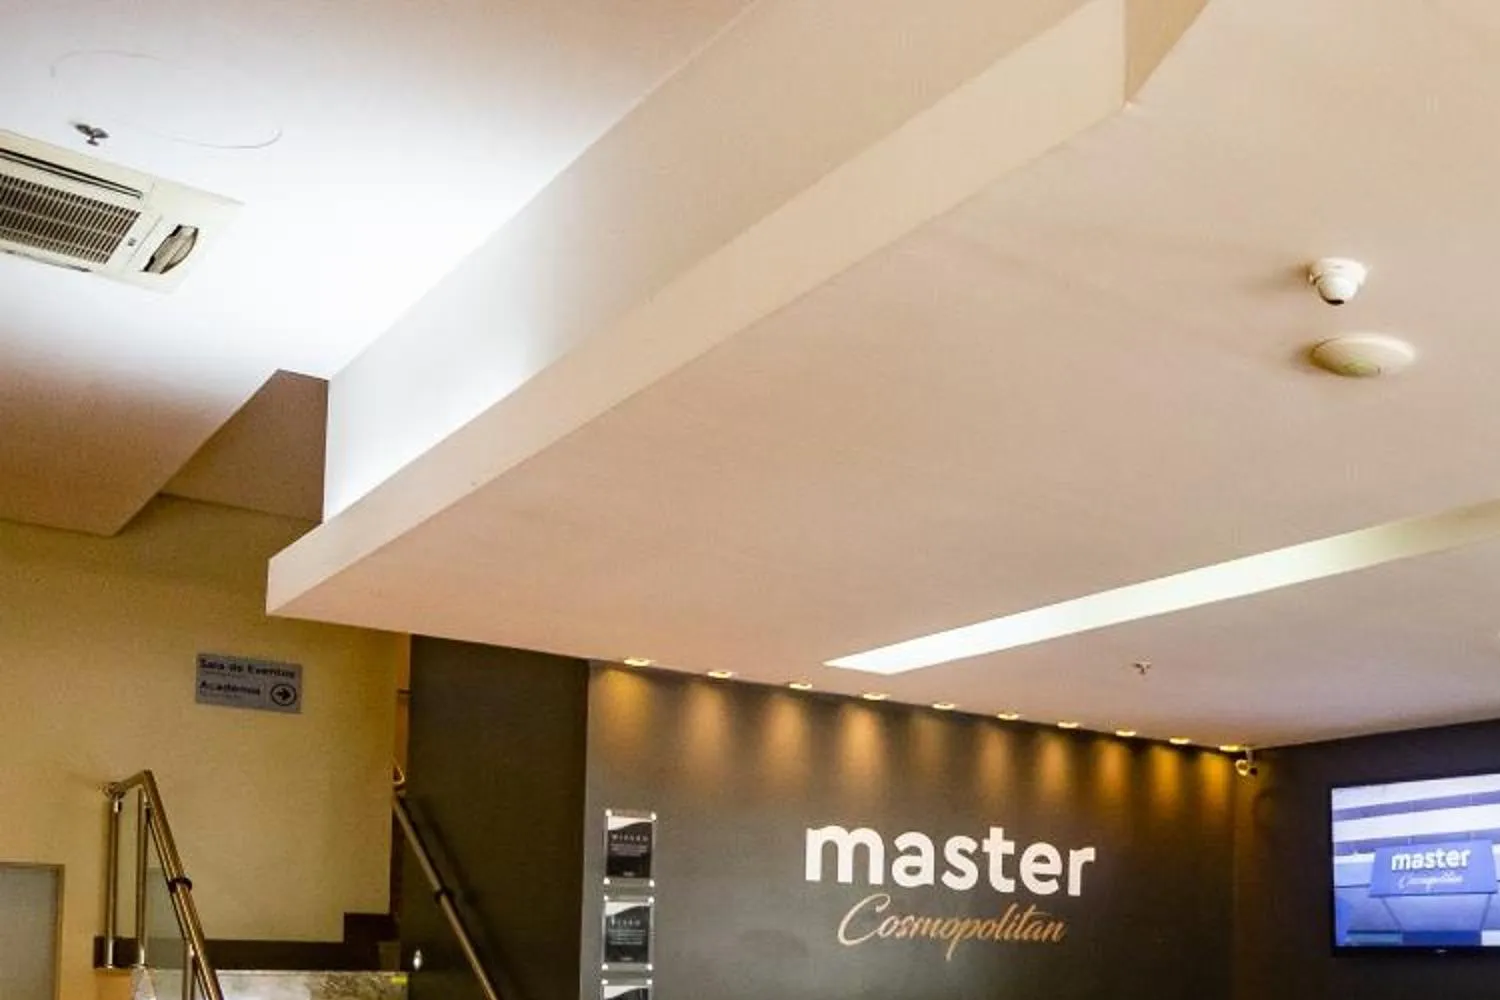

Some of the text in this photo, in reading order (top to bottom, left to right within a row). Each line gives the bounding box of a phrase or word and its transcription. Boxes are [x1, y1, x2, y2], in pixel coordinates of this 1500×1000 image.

[805, 825, 1096, 896] master
[1391, 847, 1472, 871] master
[837, 893, 1068, 961] Cosmopolitan
